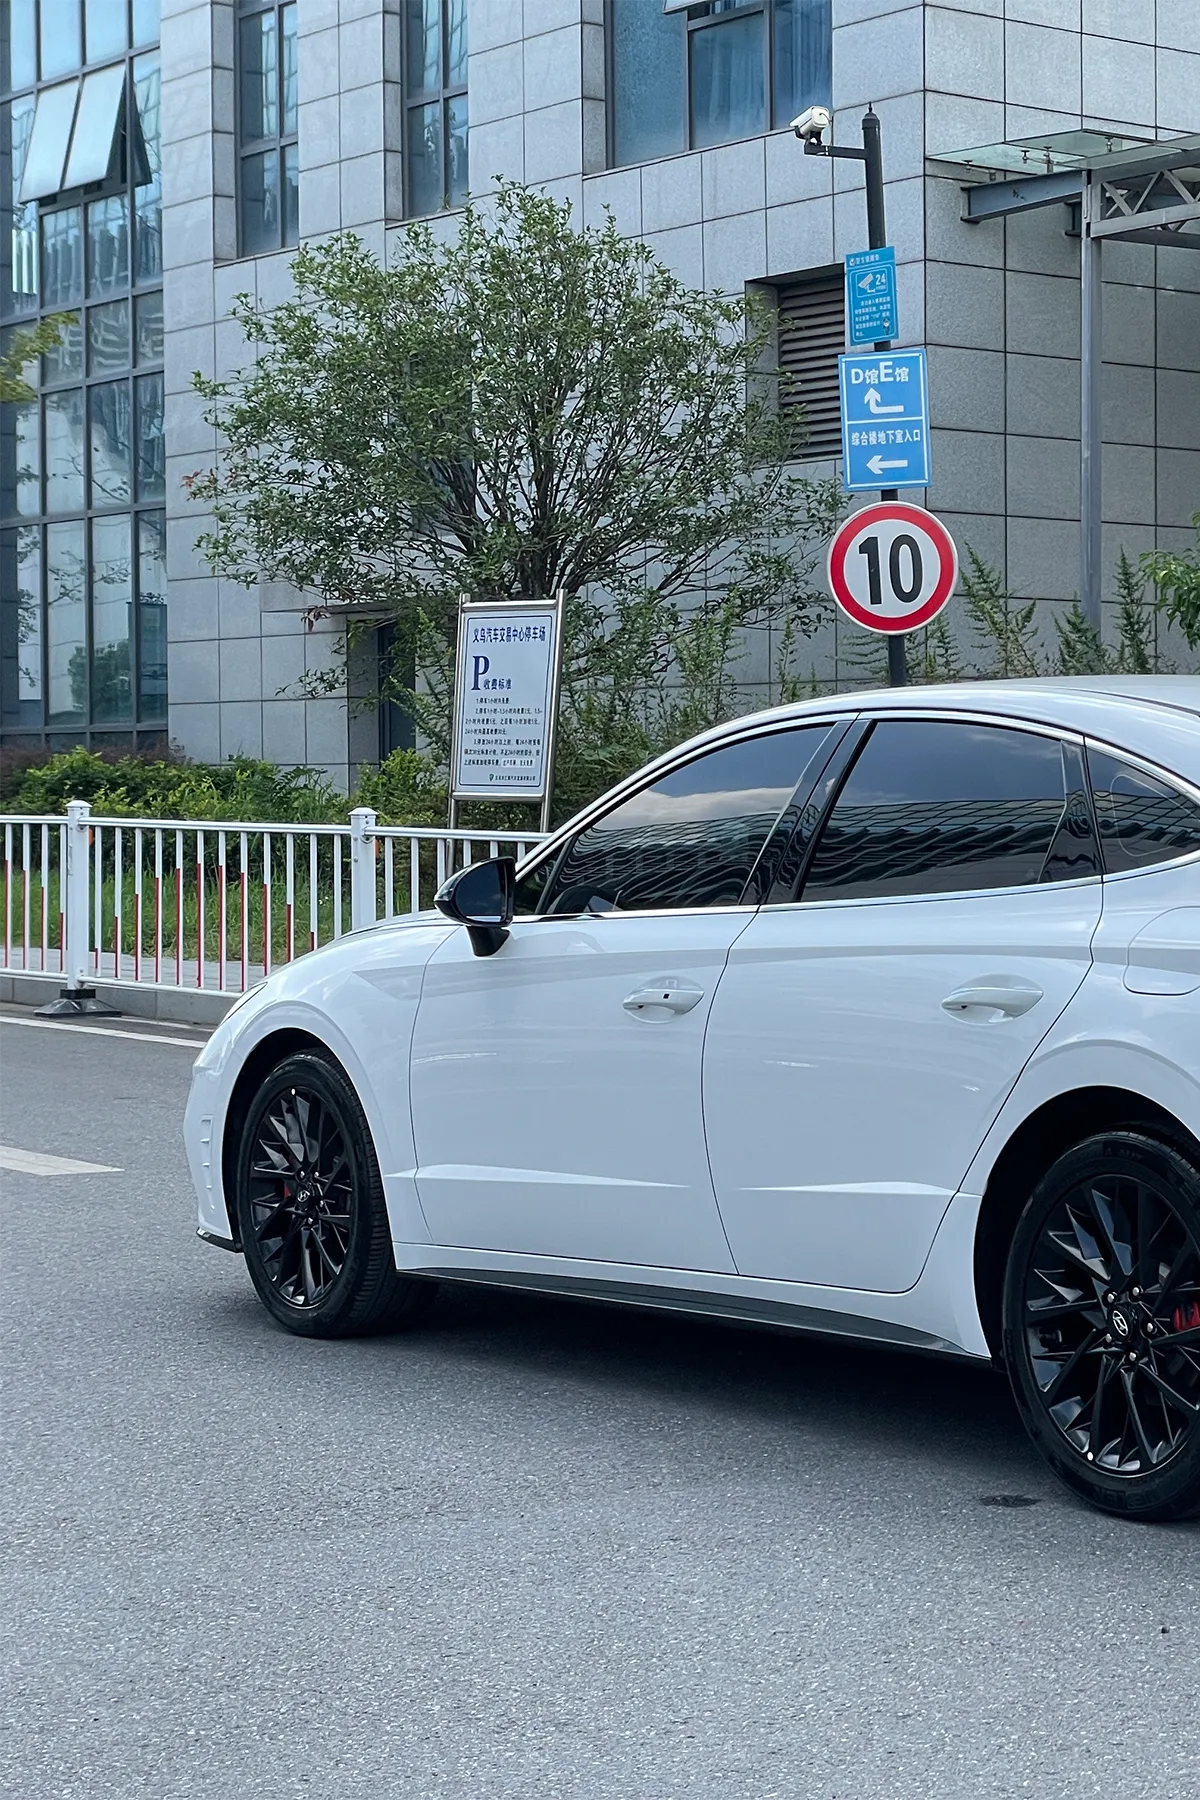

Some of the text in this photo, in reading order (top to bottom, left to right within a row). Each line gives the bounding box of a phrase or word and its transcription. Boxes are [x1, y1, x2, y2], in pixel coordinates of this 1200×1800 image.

[876, 273, 886, 285] 24
[851, 361, 909, 385] D馆E馆
[851, 429, 921, 447] 综合楼地下室入口
[858, 534, 923, 605] 10
[472, 626, 546, 643] 义乌汽车交易中心停车场
[471, 655, 490, 691] P
[483, 678, 512, 690] 收费标准
